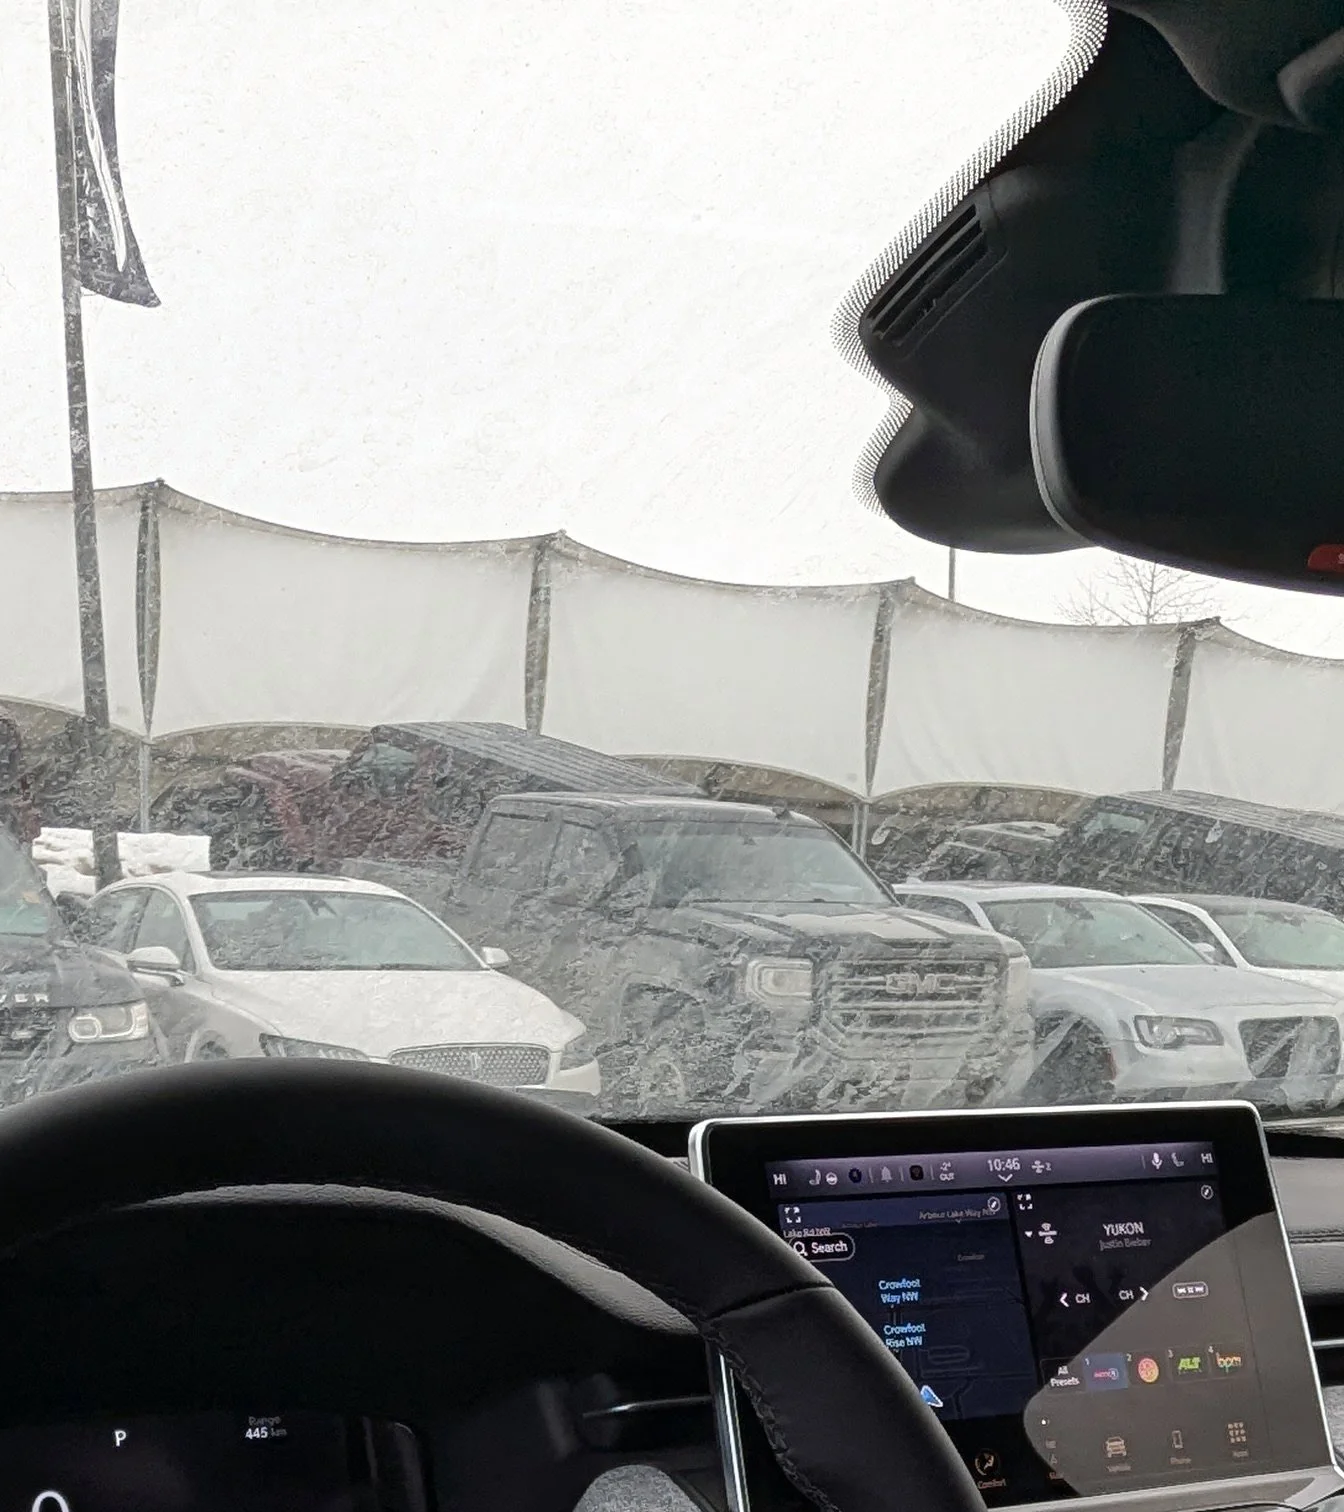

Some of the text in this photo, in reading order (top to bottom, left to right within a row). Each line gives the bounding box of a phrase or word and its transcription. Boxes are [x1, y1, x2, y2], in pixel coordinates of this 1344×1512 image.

[885, 971, 958, 994] GMC
[987, 1157, 1021, 1172] 10:46
[1201, 1152, 1214, 1165] HI
[773, 1173, 787, 1185] HI
[783, 1228, 803, 1238] Lake
[1102, 1221, 1145, 1237] YUKON
[811, 1241, 848, 1254] Search
[1099, 1239, 1124, 1251] Justin
[878, 1278, 922, 1290] Crowfoot
[1075, 1293, 1090, 1304] CH
[1118, 1289, 1134, 1300] CH
[883, 1323, 926, 1335] Crowfoot
[1057, 1365, 1069, 1376] All
[1050, 1376, 1081, 1388] Presets
[248, 1415, 282, 1427] Range
[114, 1429, 128, 1447] P
[244, 1427, 288, 1440] 445 km
